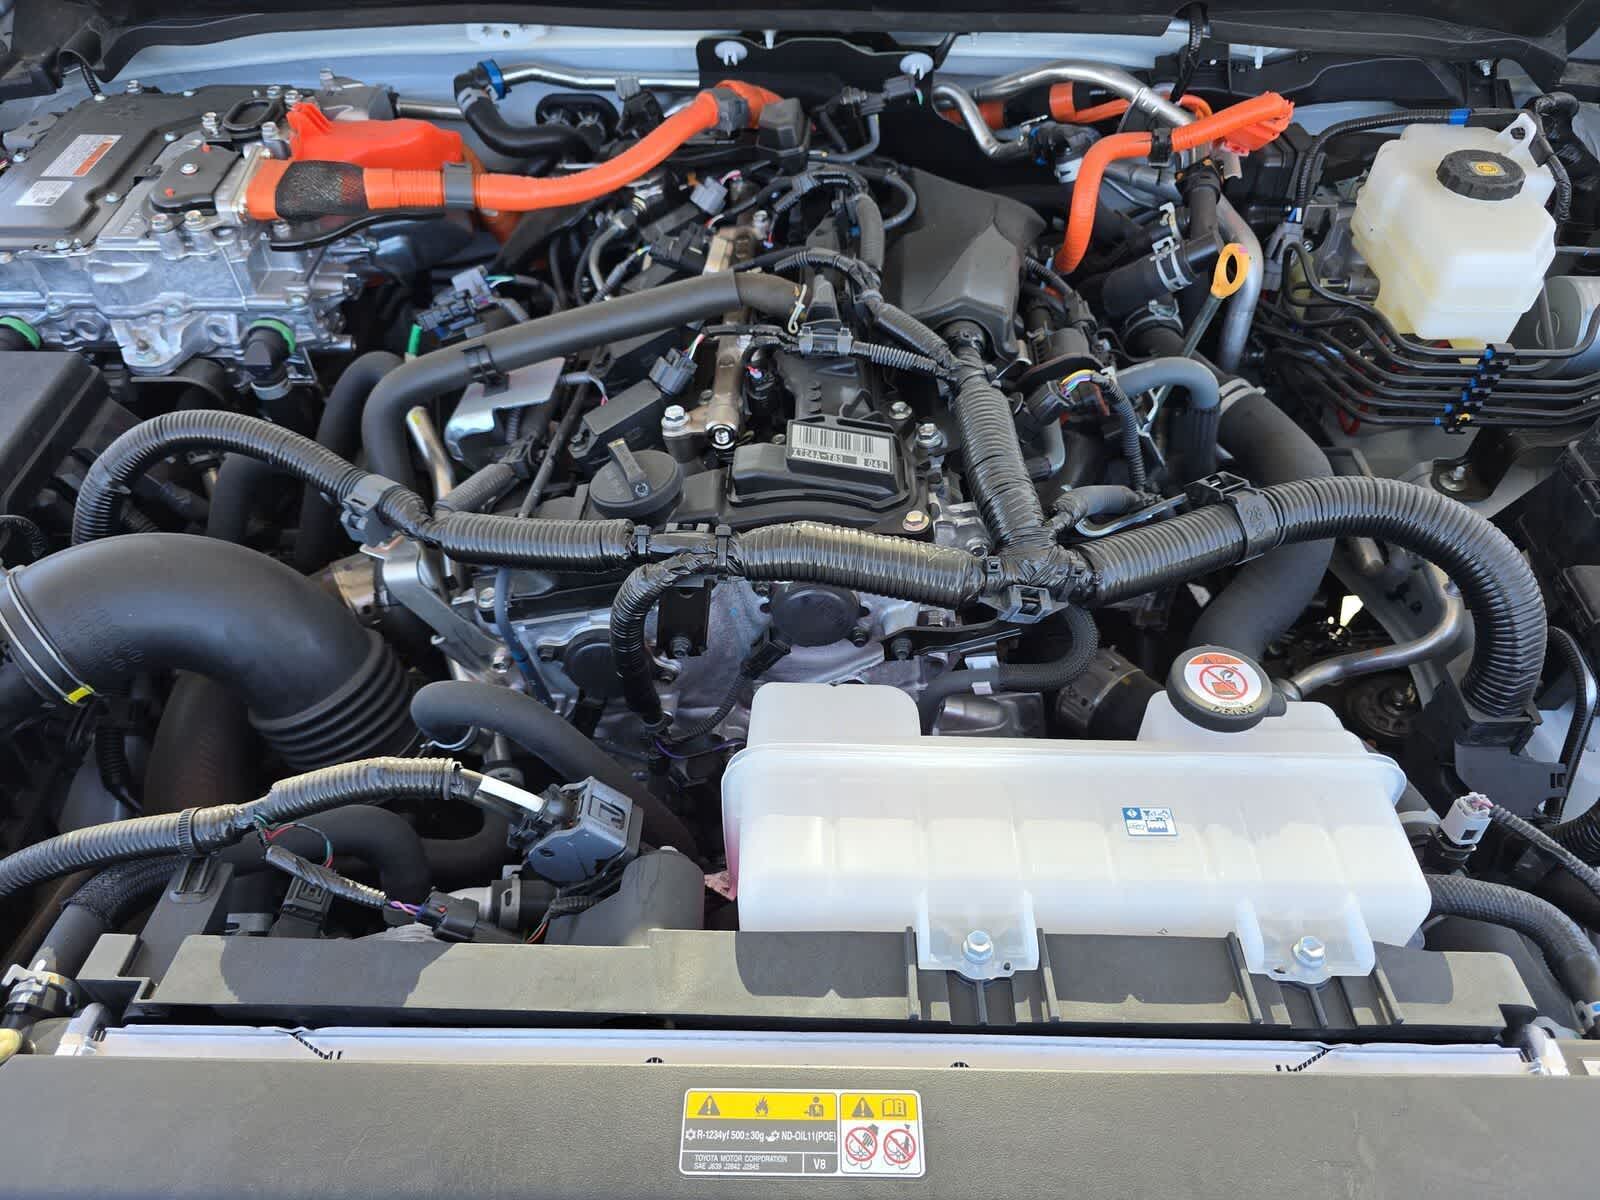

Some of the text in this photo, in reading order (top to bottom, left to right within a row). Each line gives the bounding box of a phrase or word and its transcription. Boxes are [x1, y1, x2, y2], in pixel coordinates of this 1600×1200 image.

[1211, 704, 1257, 715] DENSO
[697, 1128, 836, 1144] R-1234yf 500±30g ND-OIL11(POE)
[720, 1154, 743, 1162] MOTOR
[744, 1154, 788, 1163] CORPORATION
[813, 1158, 826, 1170] V8
